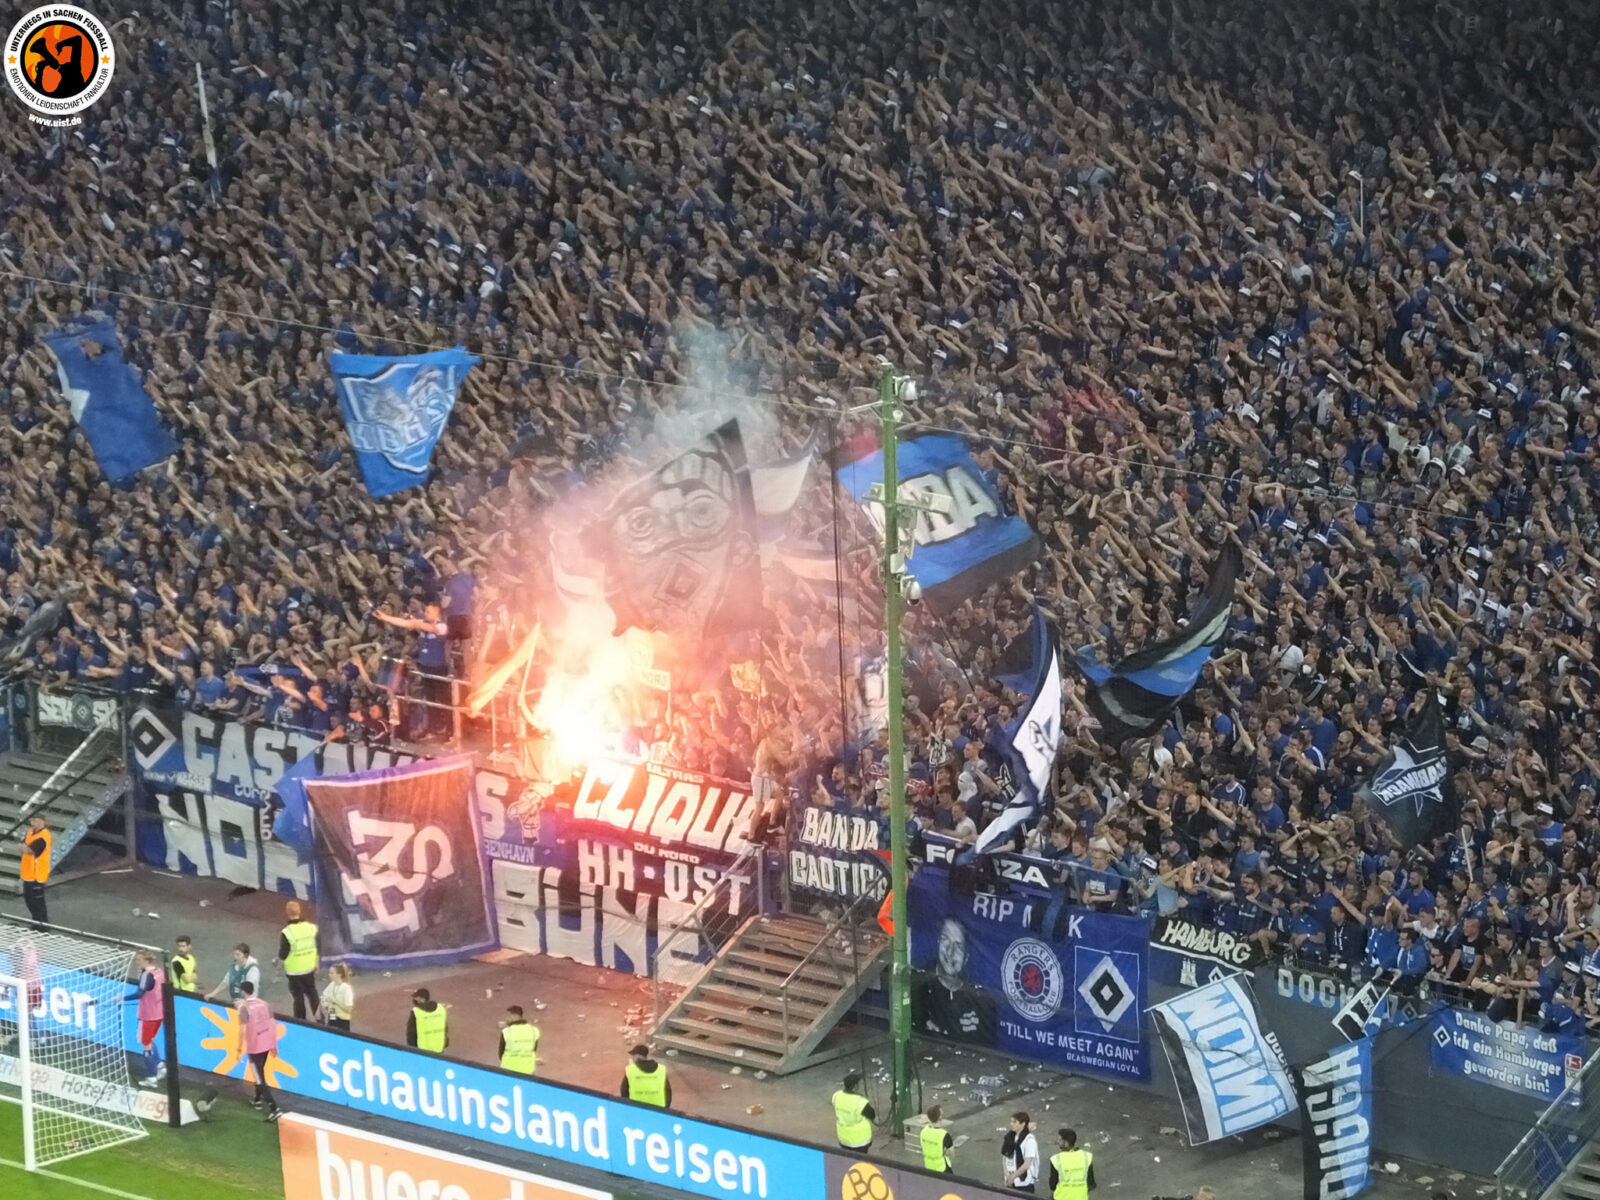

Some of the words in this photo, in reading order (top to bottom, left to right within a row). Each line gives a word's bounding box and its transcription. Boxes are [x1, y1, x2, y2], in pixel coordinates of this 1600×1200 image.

[646, 763, 704, 784] ULTRAS
[801, 807, 878, 850] BANDA
[634, 841, 655, 855] DU
[661, 849, 700, 864] NORD
[973, 894, 1014, 922] RIP
[1160, 919, 1252, 963] HAMBURG
[1011, 944, 1055, 972] RANGERS
[1036, 1030, 1054, 1046] WE
[1058, 1035, 1092, 1053] MEET
[1455, 1011, 1491, 1036] Danke
[1495, 1024, 1529, 1049] Papa,
[1533, 1034, 1557, 1053] daß
[1066, 1053, 1116, 1070] GLASWEGIAN
[1117, 1062, 1140, 1075] LOYAL
[1453, 1030, 1469, 1050] ich
[1473, 1040, 1492, 1056] ein
[1496, 1044, 1561, 1076] Hamburger
[1464, 1059, 1521, 1086] geworden
[1525, 1073, 1550, 1093] bin!
[319, 1049, 610, 1160] schauinsland
[623, 1124, 768, 1198] reisen
